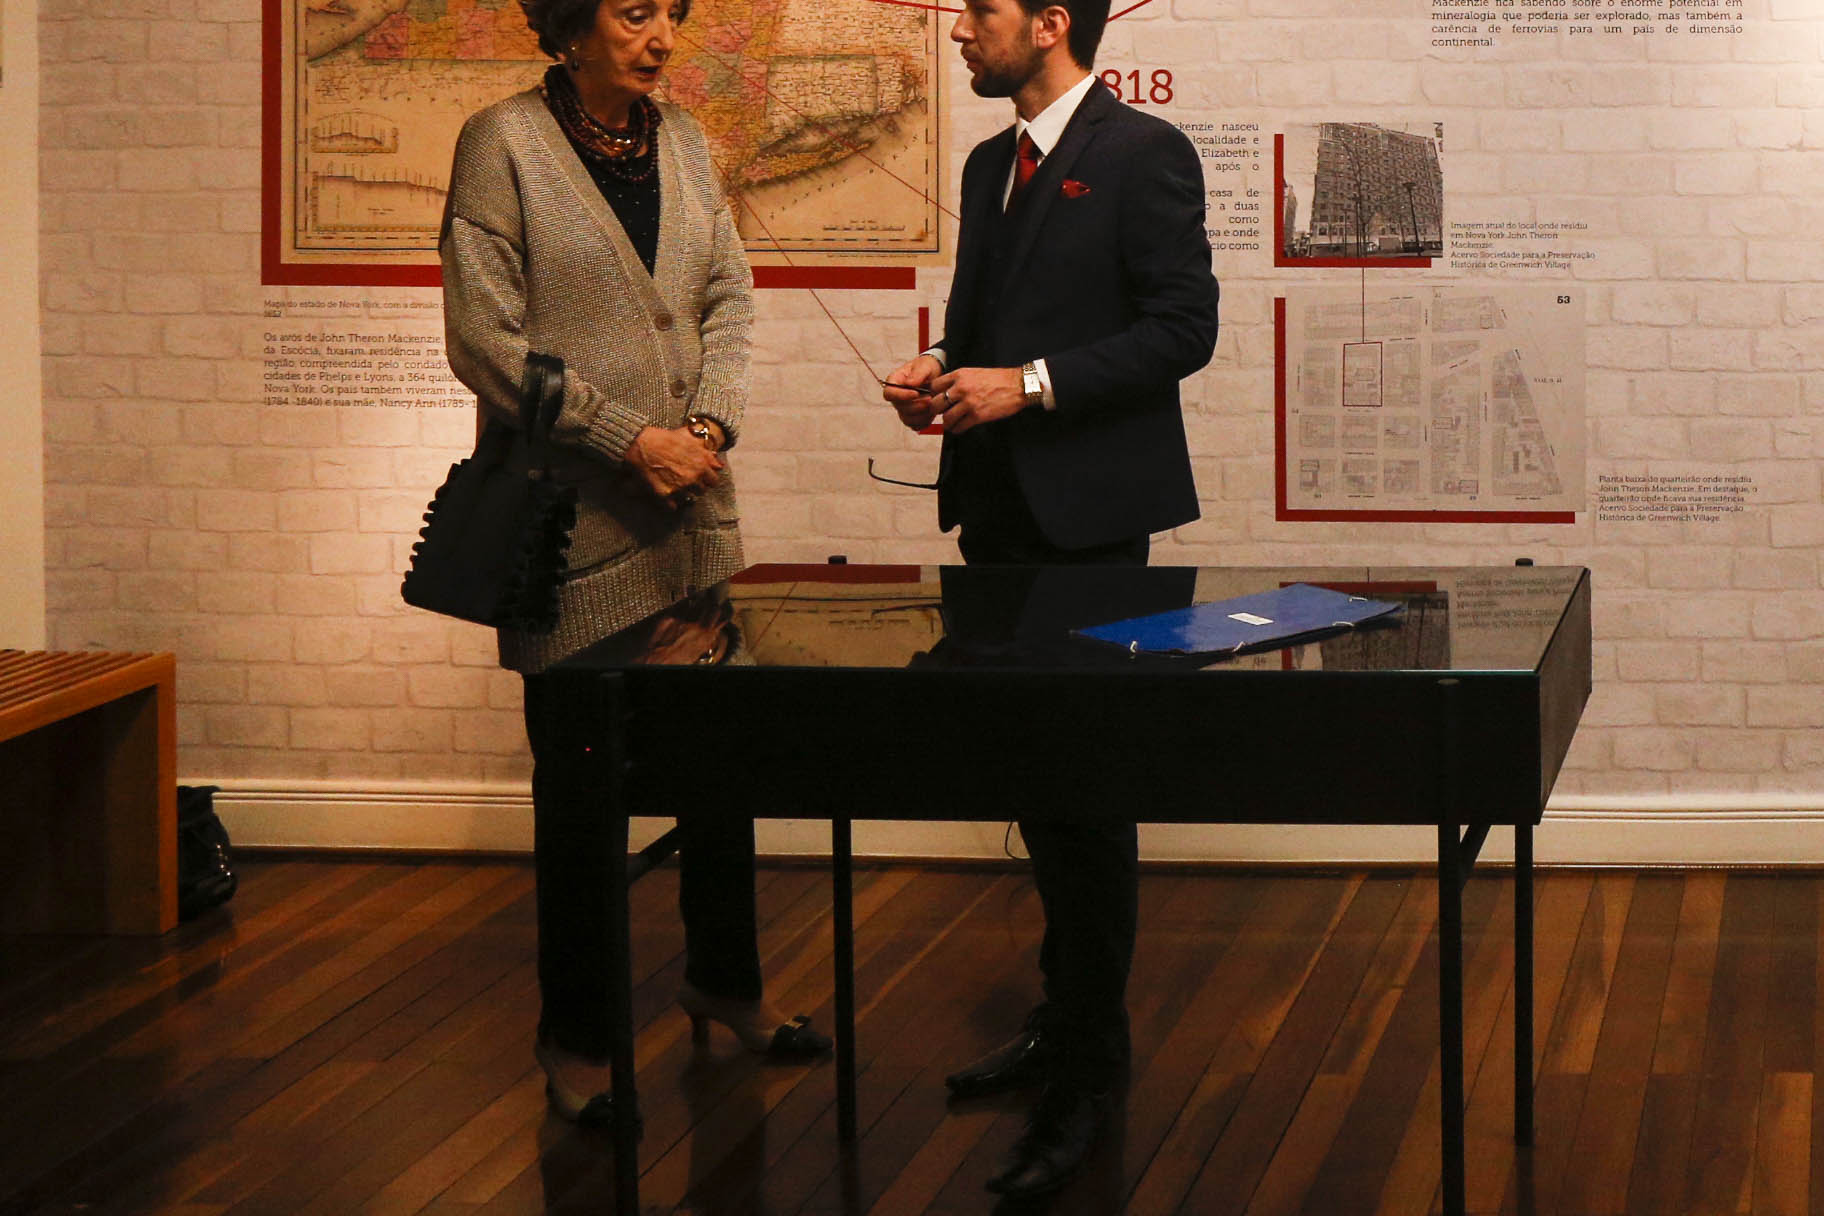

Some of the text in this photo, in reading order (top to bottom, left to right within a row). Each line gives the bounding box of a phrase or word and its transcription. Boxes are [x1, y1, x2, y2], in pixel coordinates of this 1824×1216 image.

[1607, 0, 1615, 7] o
[1620, 0, 1664, 7] enorme
[1725, 0, 1743, 7] em
[1431, 24, 1743, 35] carência de ferrovias para um país de dimensão
[1100, 68, 1174, 105] 818
[1174, 122, 1214, 131] kenzie
[1193, 135, 1259, 145] localidade e
[1201, 148, 1259, 158] Elizabeth e
[1556, 295, 1571, 305] 53
[263, 371, 301, 381] cidades
[303, 371, 317, 381] de
[319, 371, 352, 384] Phelps
[407, 372, 425, 381] 364
